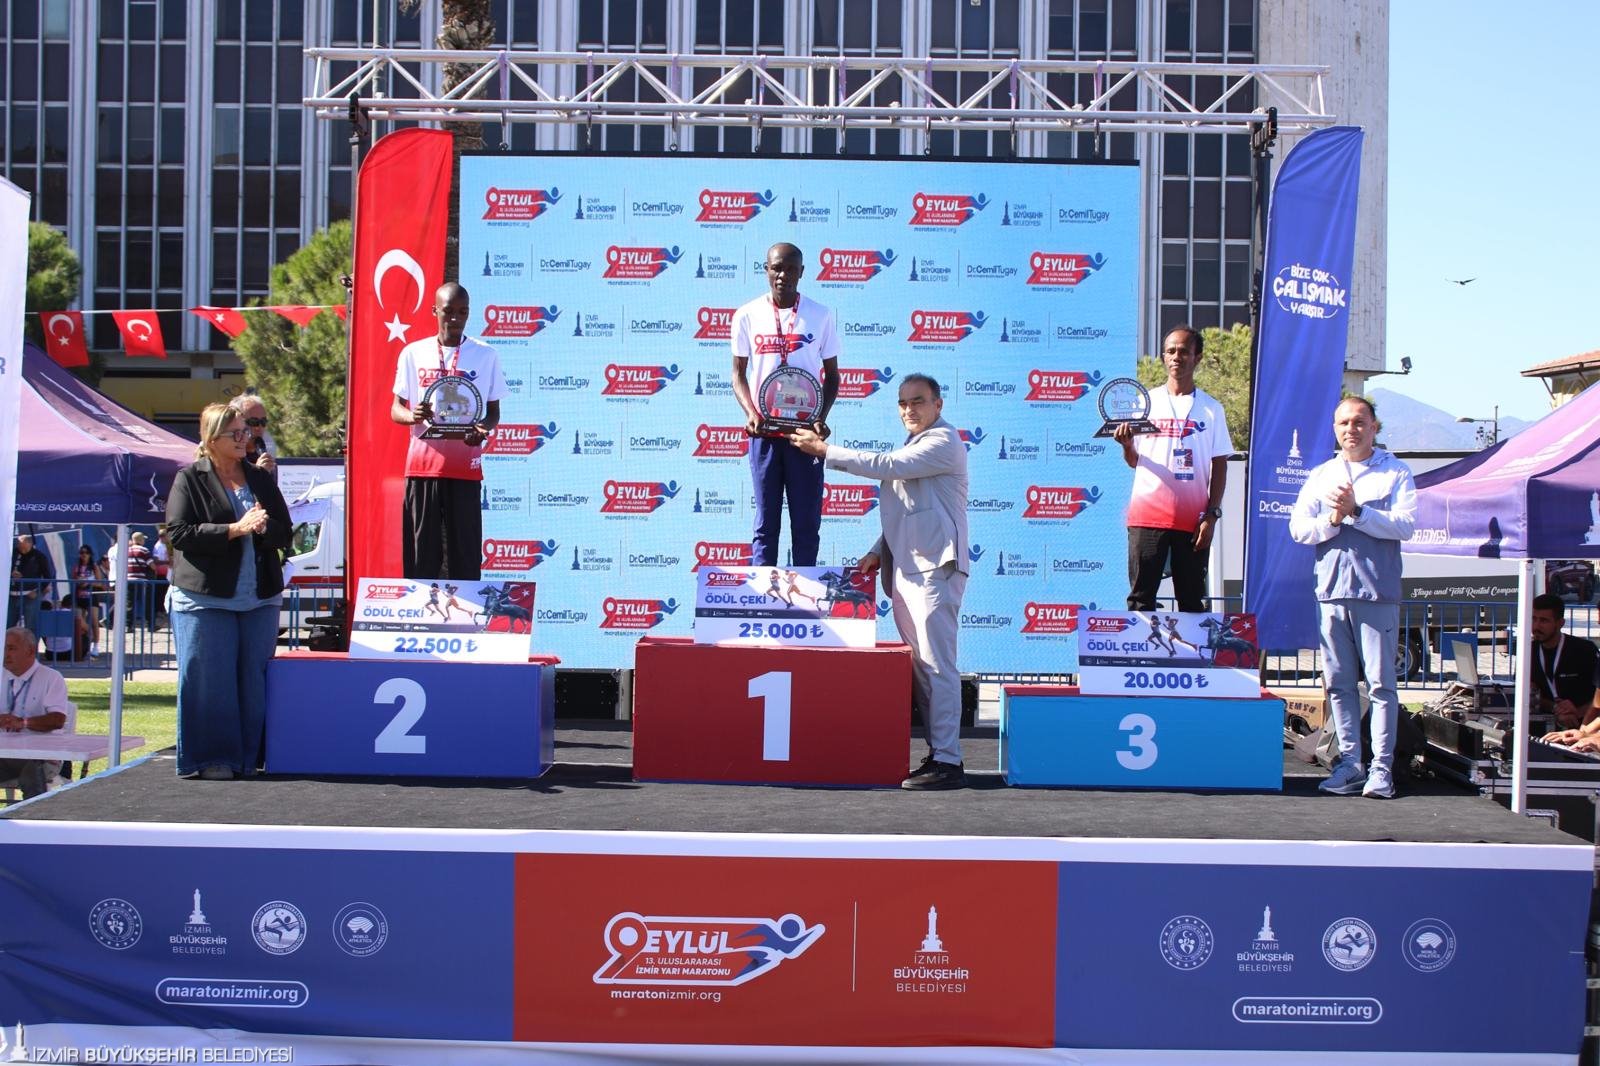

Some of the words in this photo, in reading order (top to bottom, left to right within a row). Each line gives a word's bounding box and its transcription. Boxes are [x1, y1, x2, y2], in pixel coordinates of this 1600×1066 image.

[498, 193, 533, 207] EYLÜL
[711, 195, 746, 209] EYLÜL
[925, 199, 960, 213] EYLÜL
[619, 251, 654, 265] EYLÜL
[832, 254, 867, 268] EYLÜL
[1042, 258, 1077, 272] EYLÜL
[1291, 263, 1311, 280] BİZE
[1312, 268, 1330, 284] ÇOK
[1273, 276, 1346, 307] ÇALIŞMAK
[497, 310, 532, 324] EYLÜL
[923, 315, 958, 329] EYLÜL
[617, 369, 652, 383] EYLÜL
[1040, 375, 1075, 389] EYLÜL
[709, 429, 744, 443] EYLÜL
[616, 486, 651, 500] EYLÜL
[1038, 491, 1073, 505] EYLÜL
[48, 502, 102, 513] BAŞKANLIĞI
[495, 544, 530, 558] EYLÜL
[1433, 587, 1448, 596] and
[1466, 586, 1490, 598] Rental
[705, 592, 738, 605] ÖDÜL
[739, 593, 767, 607] ÇEKİ
[363, 605, 395, 618] ÖDÜL
[397, 607, 425, 621] ÇEKİ
[615, 603, 650, 617] EYLÜL
[1036, 607, 1071, 621] EYLÜL
[738, 622, 807, 640] 25.000
[394, 637, 461, 655] 22.500
[1087, 639, 1120, 651] ÖDÜL
[1121, 640, 1149, 655] ÇEKİ
[1124, 671, 1192, 689] 20.000
[373, 677, 427, 754] 2
[748, 671, 792, 761] 1
[1115, 713, 1159, 771] 3
[184, 924, 212, 934] İZMİR
[169, 934, 227, 945] BÜYÜKŞEHİR
[646, 929, 733, 955] EYLÜL
[1251, 941, 1279, 951] İZMİR
[172, 945, 226, 955] BELEDİYESİ
[1236, 951, 1294, 963] BÜYÜKŞEHİR
[645, 957, 656, 966] 13.
[658, 957, 722, 966] ULUSLARARASI
[914, 953, 950, 966] İZMİR
[635, 965, 661, 975] İZMİR
[661, 967, 680, 975] YARI
[681, 967, 731, 976] MARATONU
[894, 966, 969, 982] BÜYÜKŞEHİR
[1238, 962, 1292, 972] BELEDİYESİ
[896, 979, 966, 993] BELEDİYESİ
[165, 984, 299, 1003] maratonizmir.org
[610, 989, 721, 1003] maratonizmir.org
[1241, 1001, 1374, 1020] maratonizmir.org
